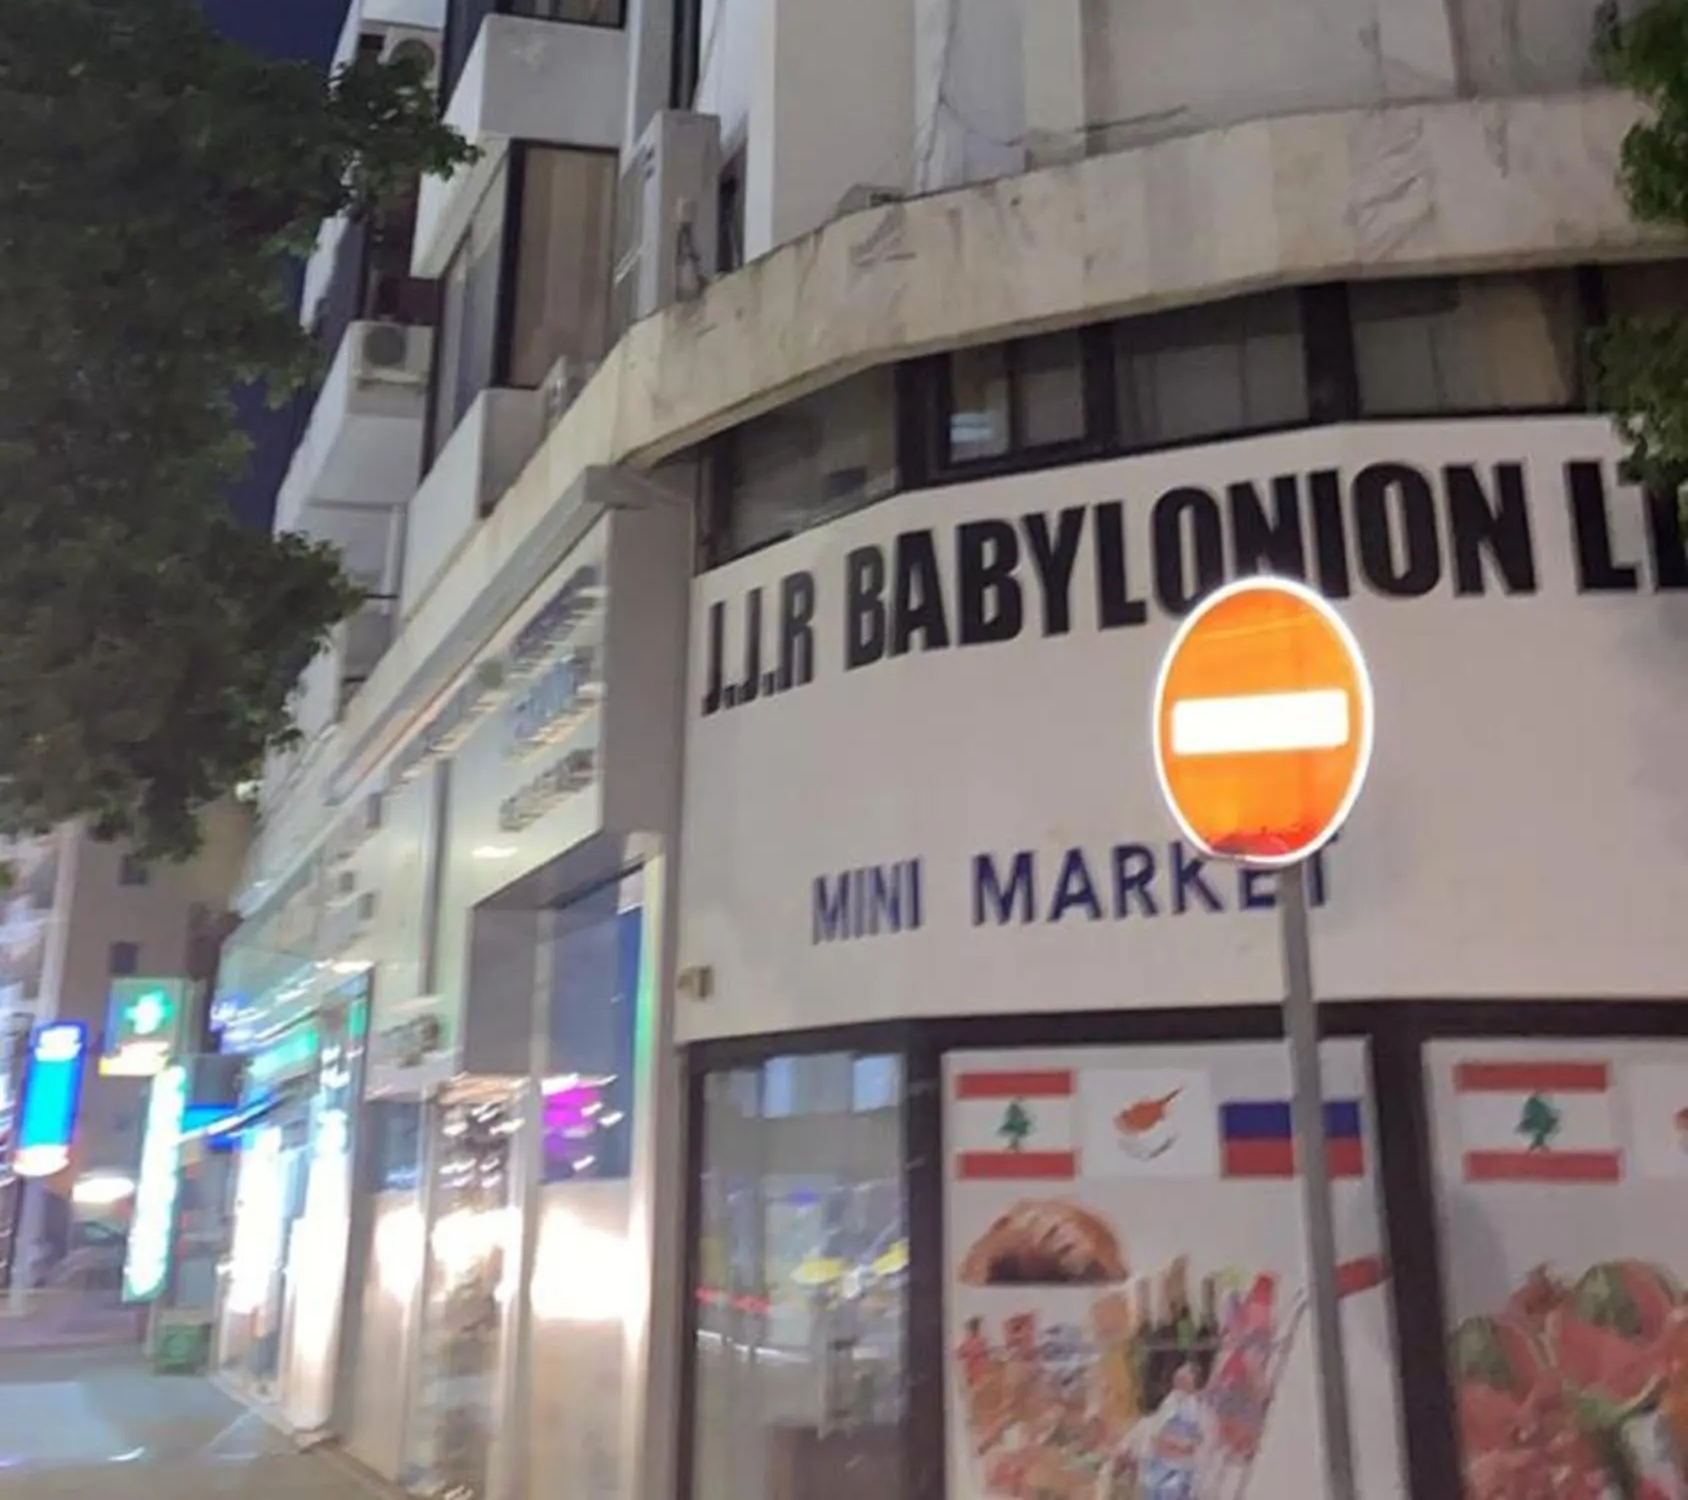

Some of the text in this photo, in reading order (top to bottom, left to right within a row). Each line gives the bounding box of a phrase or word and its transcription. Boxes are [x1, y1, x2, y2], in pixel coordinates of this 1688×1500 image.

[701, 570, 815, 717] J.J.R
[844, 460, 1538, 672] BABYLONION
[812, 856, 922, 946] MINI
